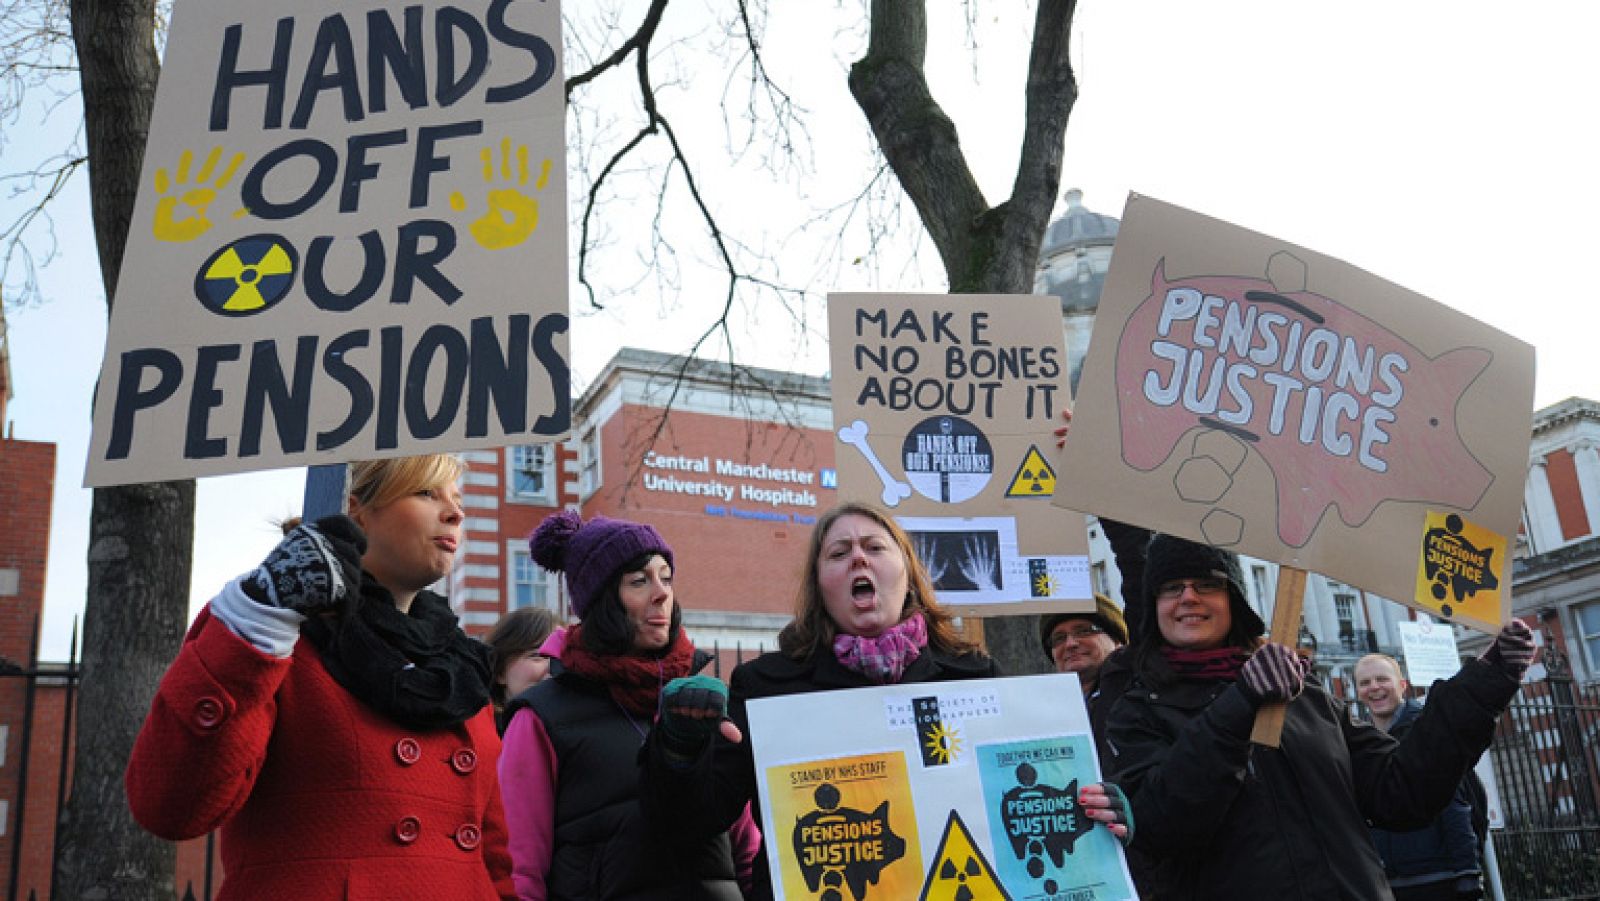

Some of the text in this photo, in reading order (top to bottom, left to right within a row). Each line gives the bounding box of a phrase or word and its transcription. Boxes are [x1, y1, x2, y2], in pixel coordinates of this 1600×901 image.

[209, 0, 556, 131] HANDS
[241, 120, 483, 219] OFF
[855, 308, 992, 347] MAKE
[854, 344, 1060, 380] NO BONES
[1156, 287, 1408, 409] PENSIONS
[105, 313, 571, 460] PENSIONS
[857, 376, 1058, 419] ABOUT IT
[1143, 340, 1397, 473] JUSTICE
[643, 450, 815, 485] Central Manchester
[643, 473, 817, 508] University Hospitals
[1427, 548, 1482, 585] JUSTICE
[1429, 535, 1485, 567] PENSIONS
[790, 760, 887, 784] STAND BY NHS STAFF
[1007, 796, 1074, 816] PENSIONS
[801, 819, 882, 843] PENSIONS
[1010, 814, 1076, 836] JUSTICE
[803, 840, 884, 867] JUSTICE
